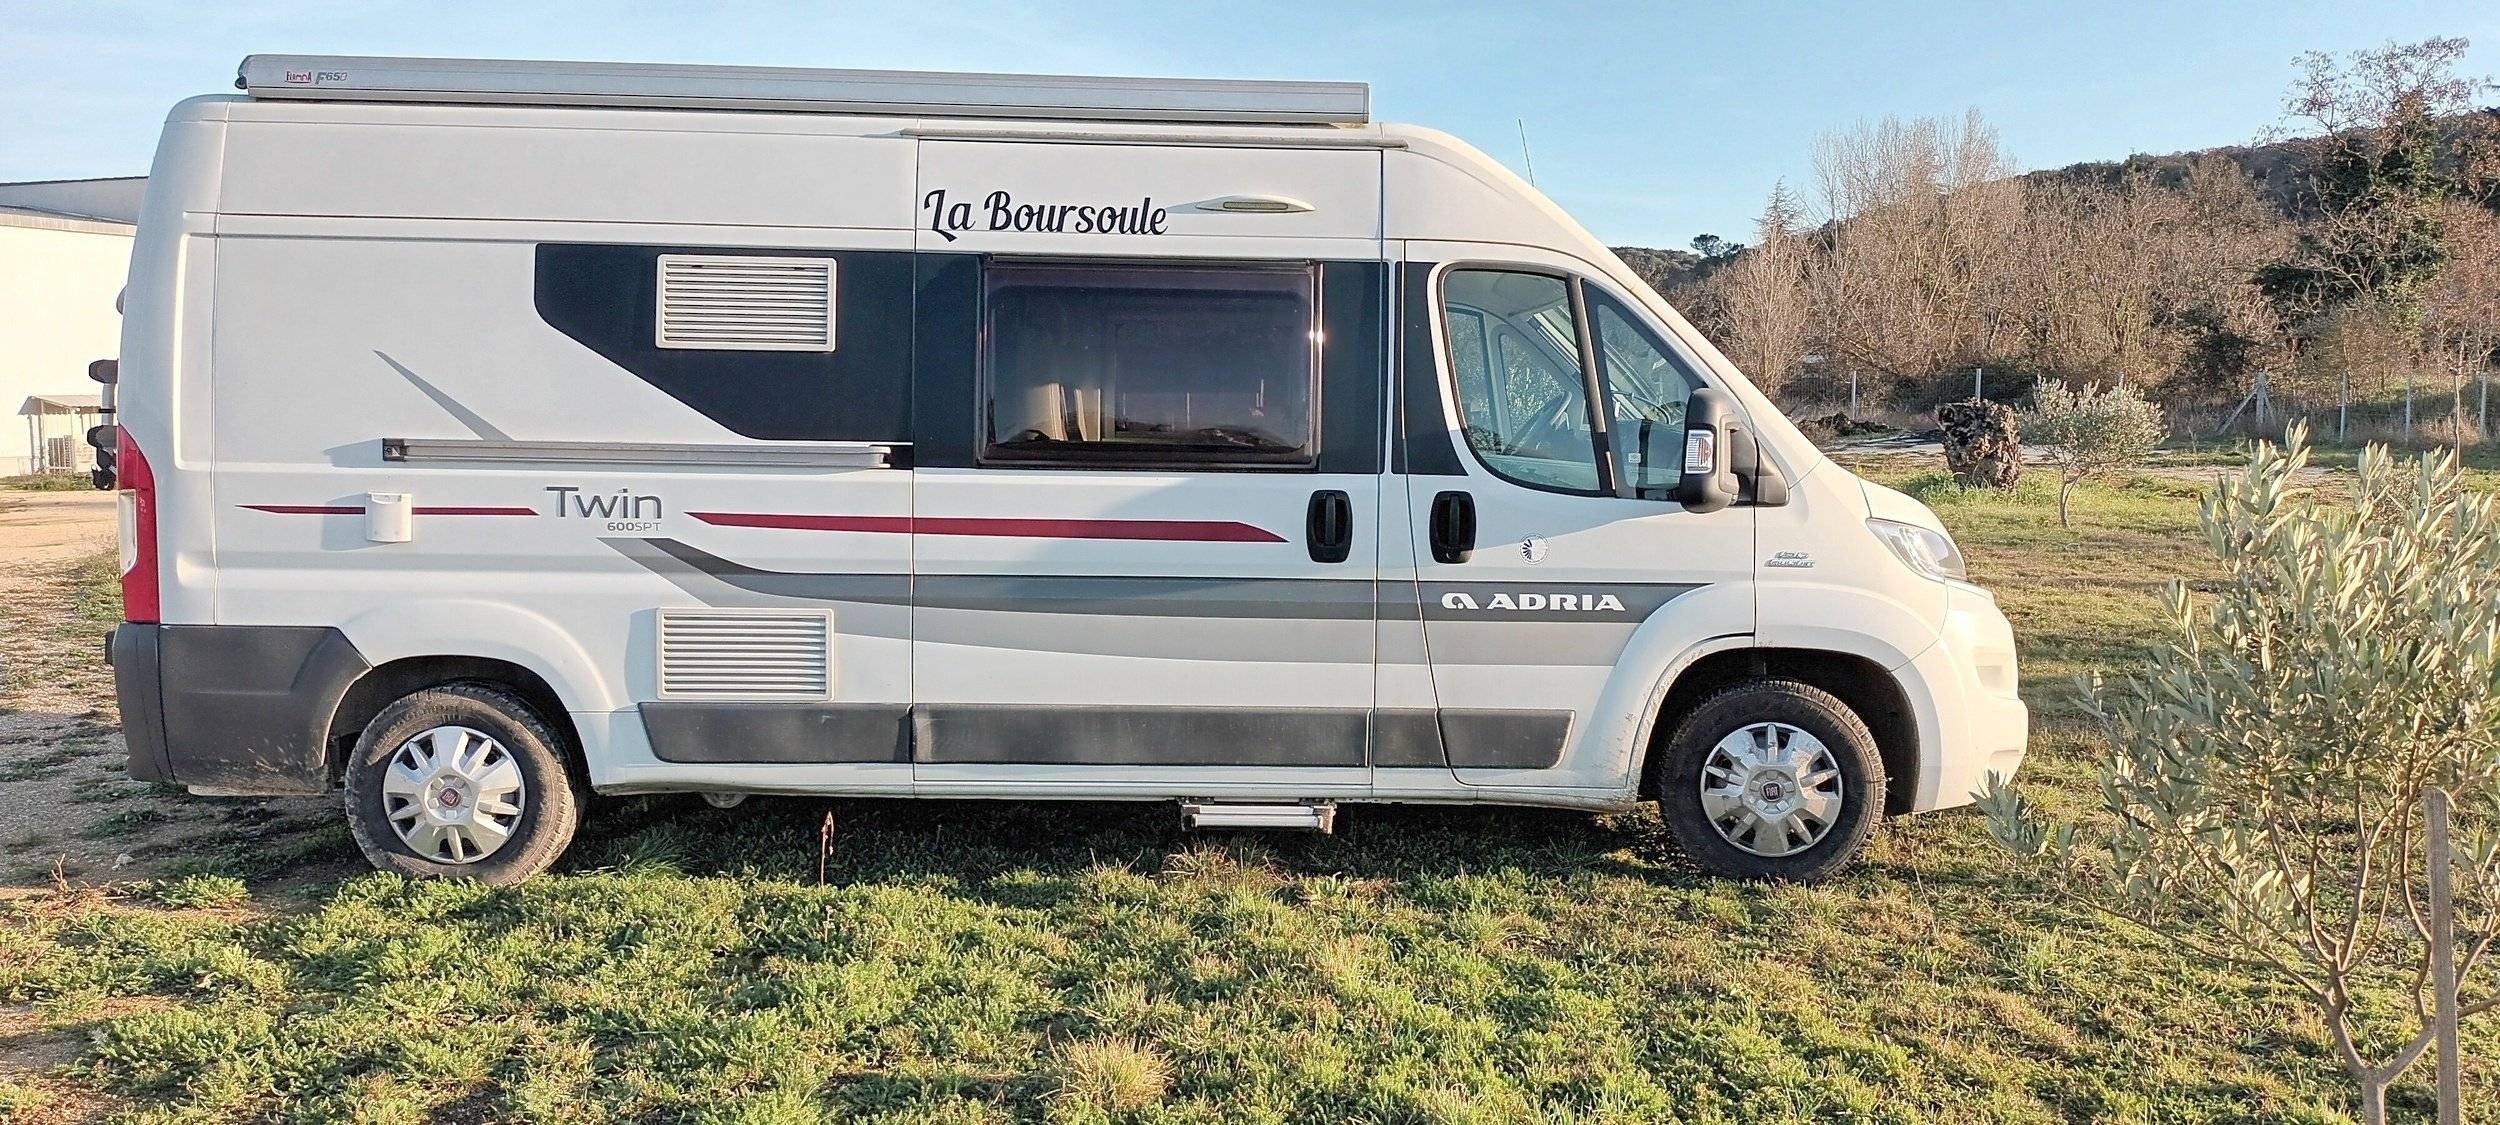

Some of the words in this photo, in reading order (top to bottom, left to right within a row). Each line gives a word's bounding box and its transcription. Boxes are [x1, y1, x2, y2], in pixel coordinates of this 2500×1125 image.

[923, 189, 975, 242] La
[983, 190, 1168, 235] Boursoule
[545, 486, 662, 519] Twin
[607, 522, 662, 532] 600SPT
[1487, 593, 1627, 611] ADRIA
